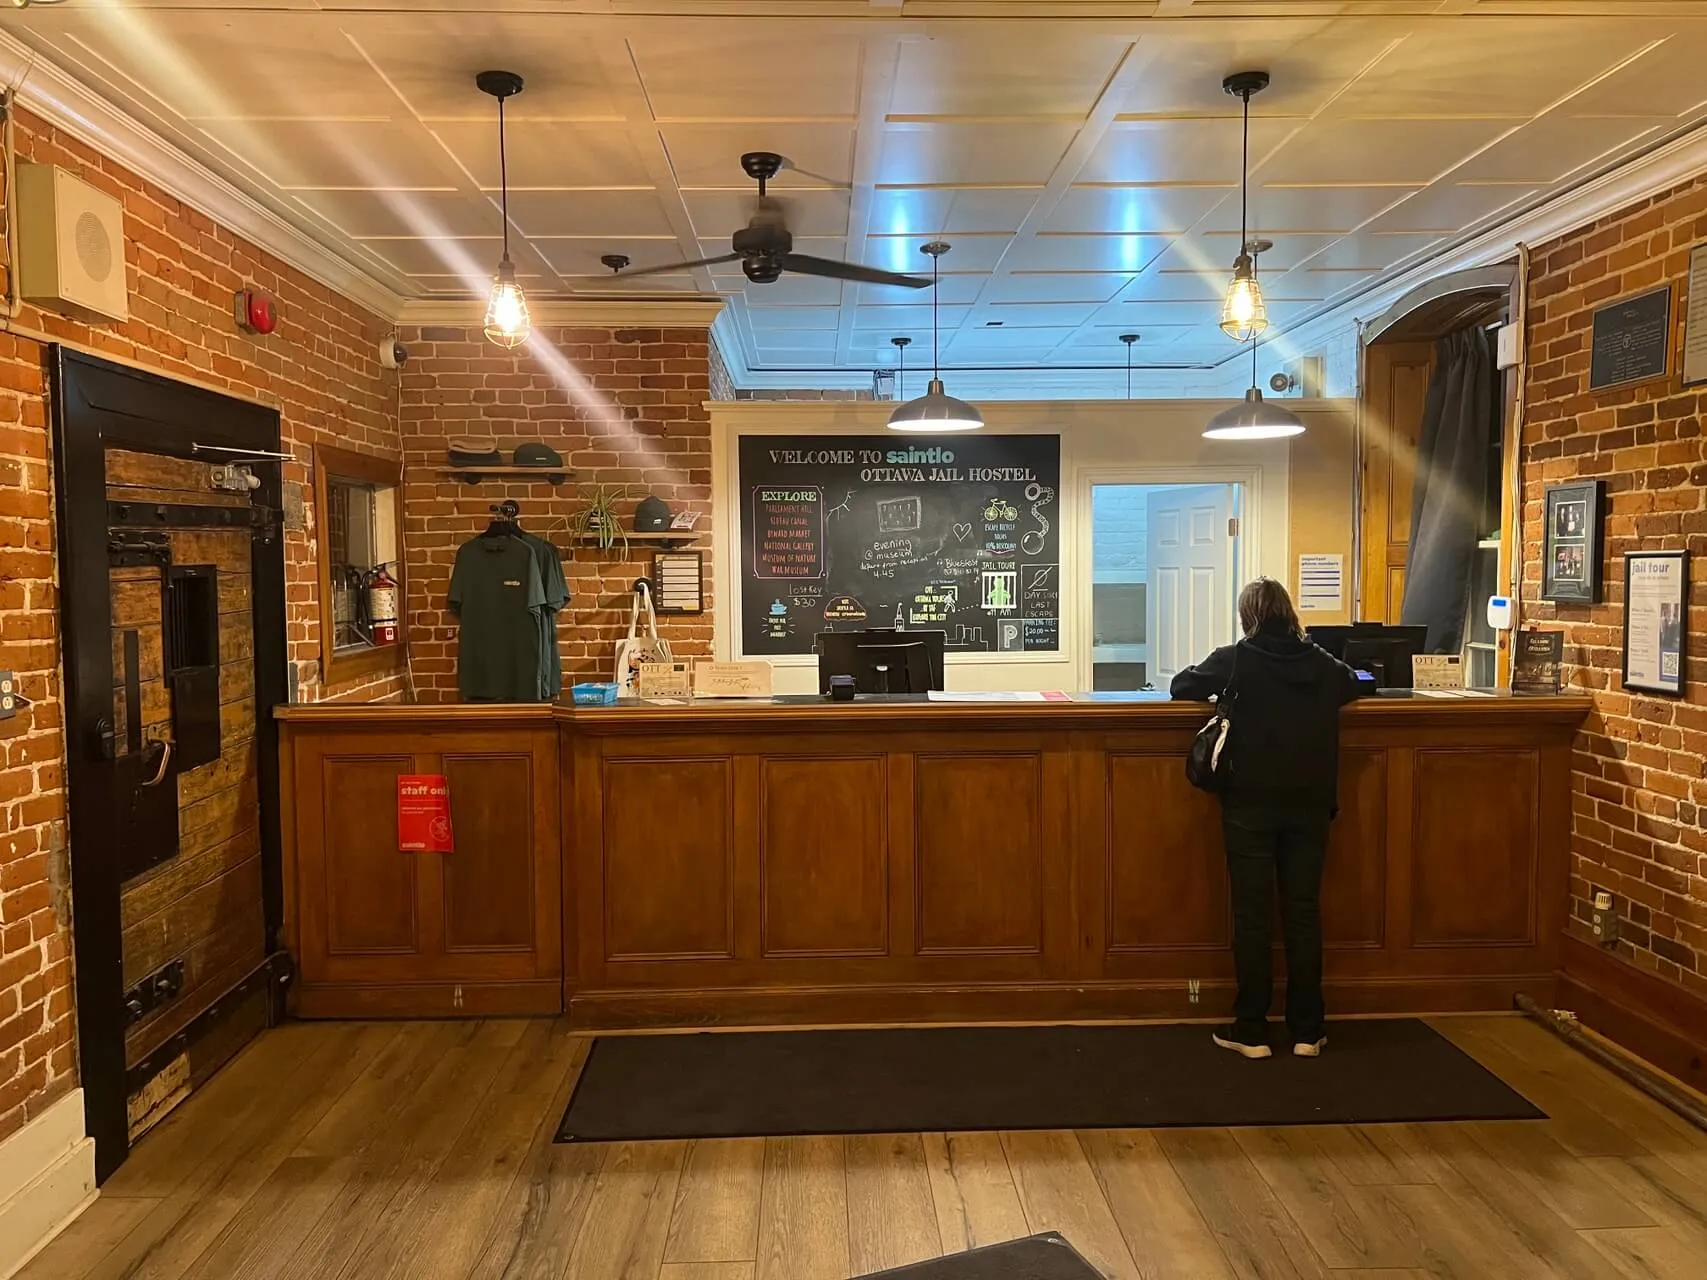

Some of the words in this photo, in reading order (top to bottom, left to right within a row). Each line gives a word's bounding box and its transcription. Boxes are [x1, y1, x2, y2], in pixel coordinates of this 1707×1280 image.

[769, 450, 854, 464] WELCOME
[859, 450, 881, 464] TO
[886, 446, 955, 464] saintlo
[860, 468, 925, 482] OTTAWA
[929, 468, 963, 482] JAIL
[969, 468, 1036, 482] HOSTEL
[761, 491, 816, 502] EXPLORE
[789, 530, 811, 538] MARKET
[873, 539, 912, 553] evening
[876, 551, 913, 560] museum
[982, 561, 997, 570] JAIL
[1632, 561, 1646, 575] jail
[1648, 563, 1670, 574] tour
[792, 597, 816, 608] $30
[1030, 601, 1050, 609] LAST
[1004, 624, 1018, 649] P
[401, 786, 428, 795] staff
